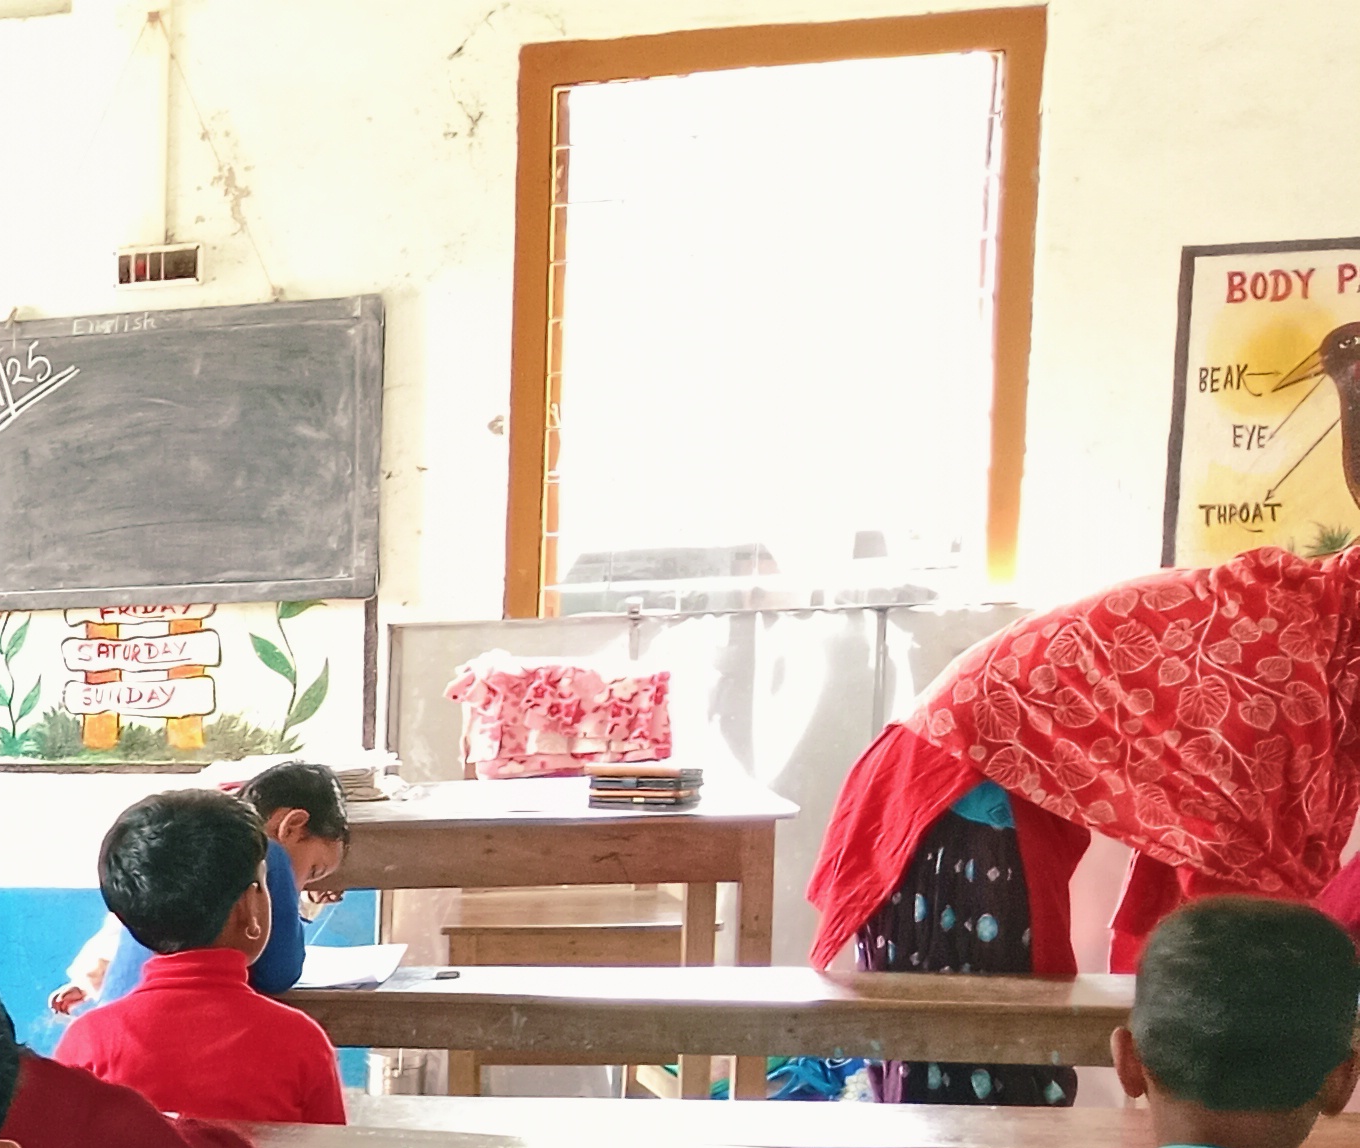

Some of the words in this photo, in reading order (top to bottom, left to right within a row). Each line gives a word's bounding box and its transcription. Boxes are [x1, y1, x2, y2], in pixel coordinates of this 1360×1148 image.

[1226, 268, 1315, 304] BODY
[1338, 263, 1360, 294] P
[1199, 363, 1258, 396] BEAK
[1232, 425, 1269, 450] EYE
[1198, 503, 1282, 530] THROAT
[77, 641, 188, 662] SATURDAY
